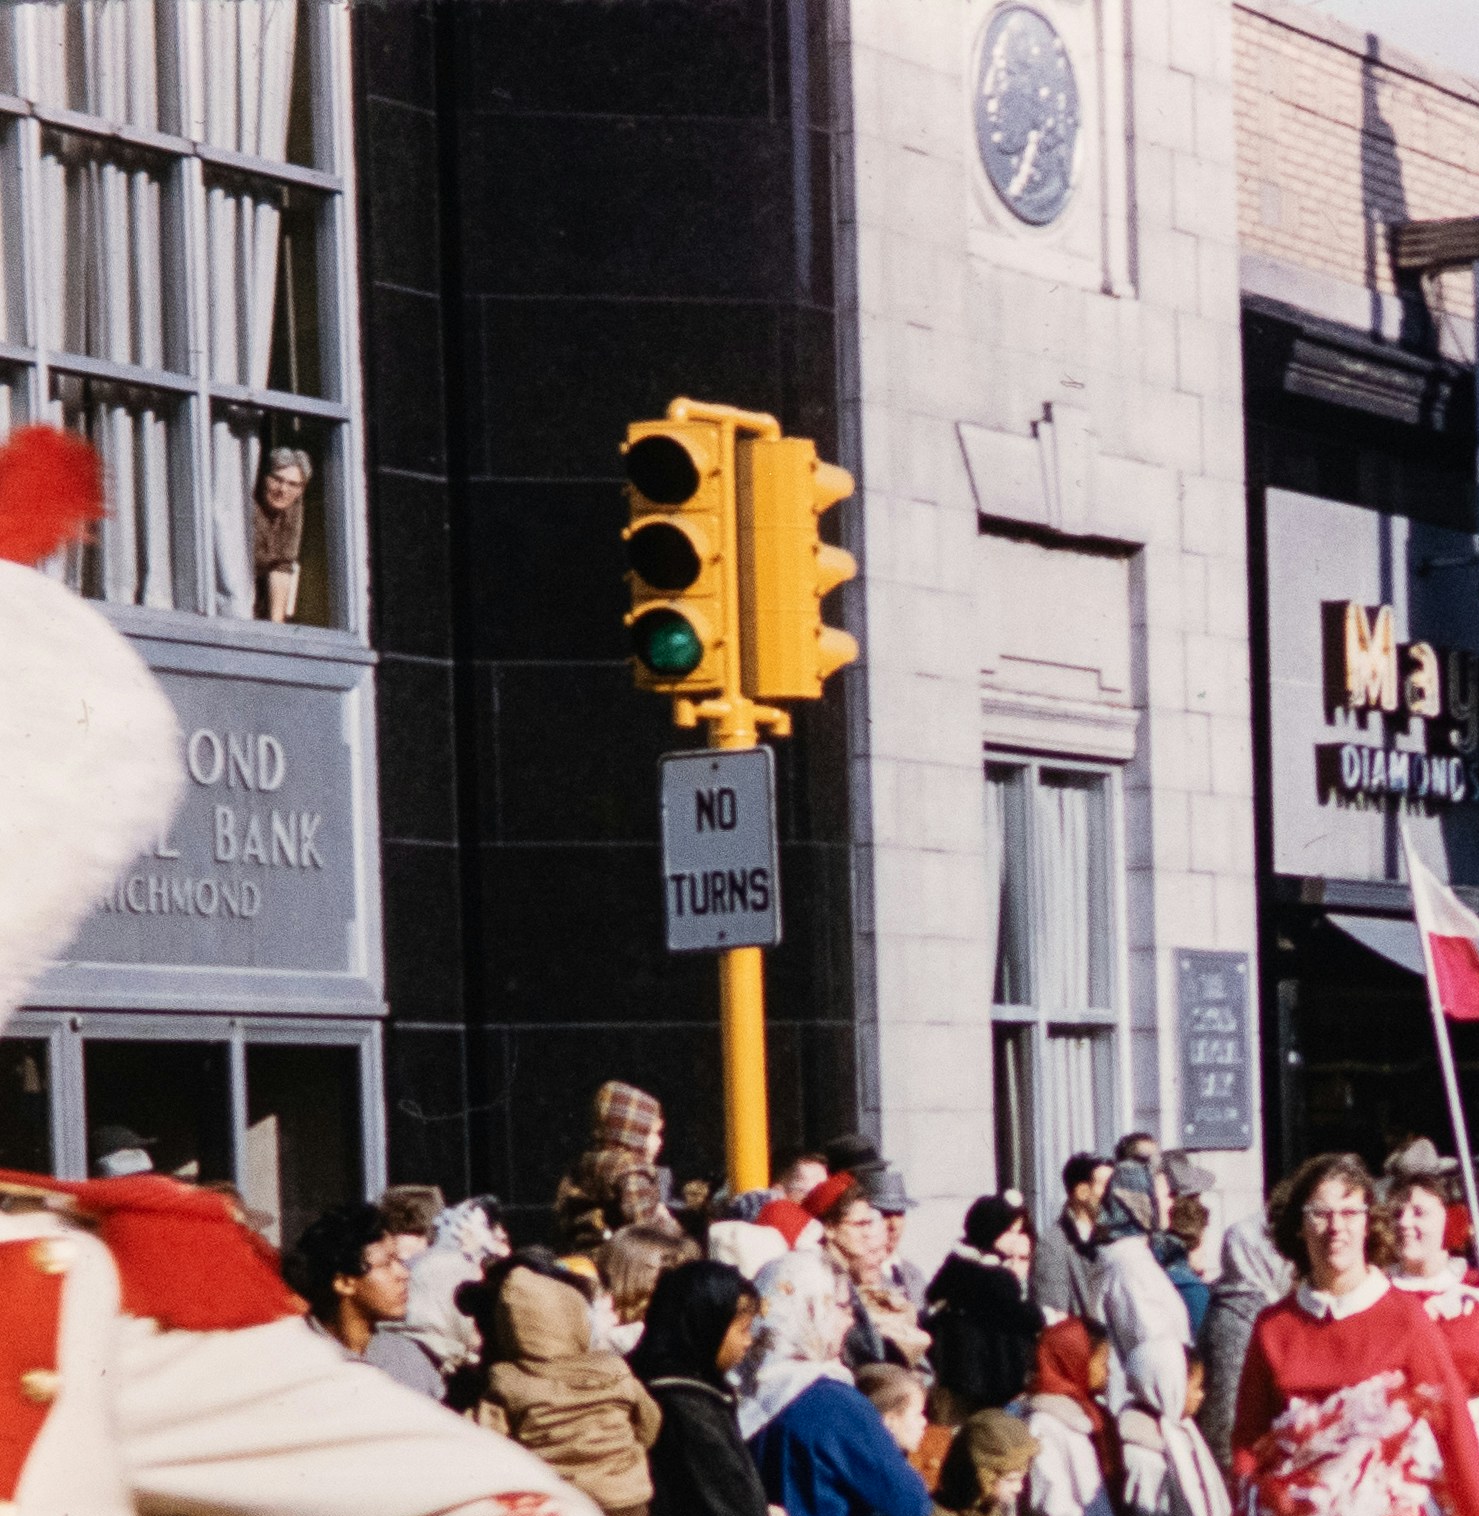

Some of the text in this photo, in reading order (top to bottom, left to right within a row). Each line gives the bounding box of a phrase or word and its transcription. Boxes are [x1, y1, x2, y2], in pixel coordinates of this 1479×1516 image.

[695, 787, 736, 832] NO
[213, 804, 322, 870] BANK
[670, 867, 770, 917] TURNS
